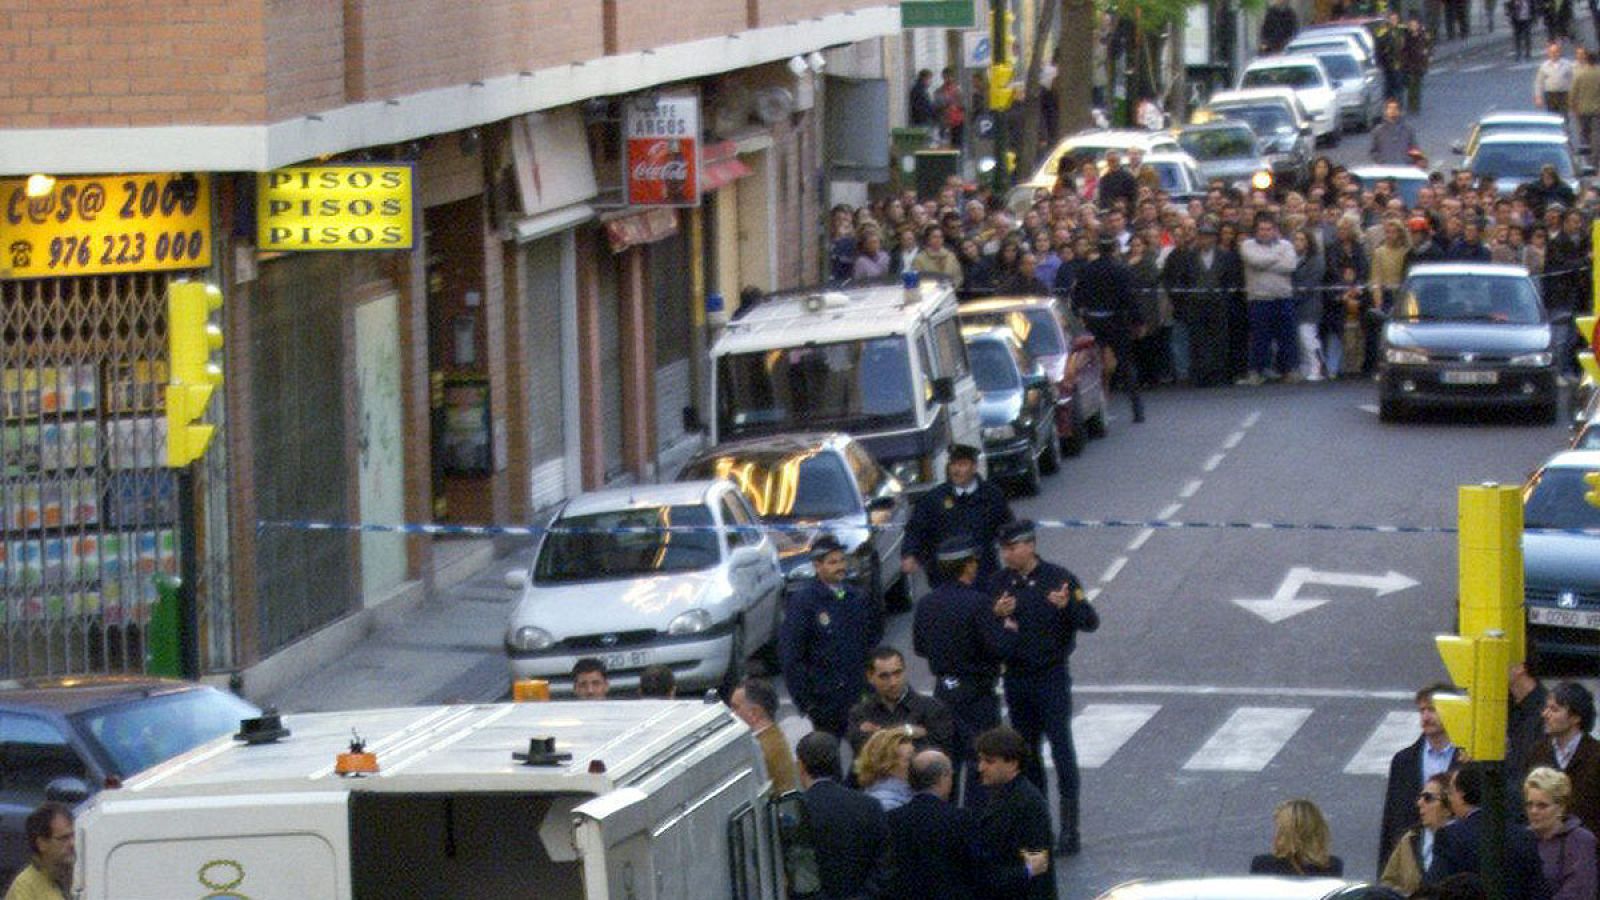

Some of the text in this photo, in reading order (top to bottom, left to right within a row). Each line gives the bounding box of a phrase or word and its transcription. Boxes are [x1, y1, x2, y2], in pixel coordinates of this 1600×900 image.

[269, 171, 402, 189] PISOS
[269, 199, 402, 216] PISOS
[270, 226, 403, 244] PISOS
[48, 230, 202, 268] 976 223 000
